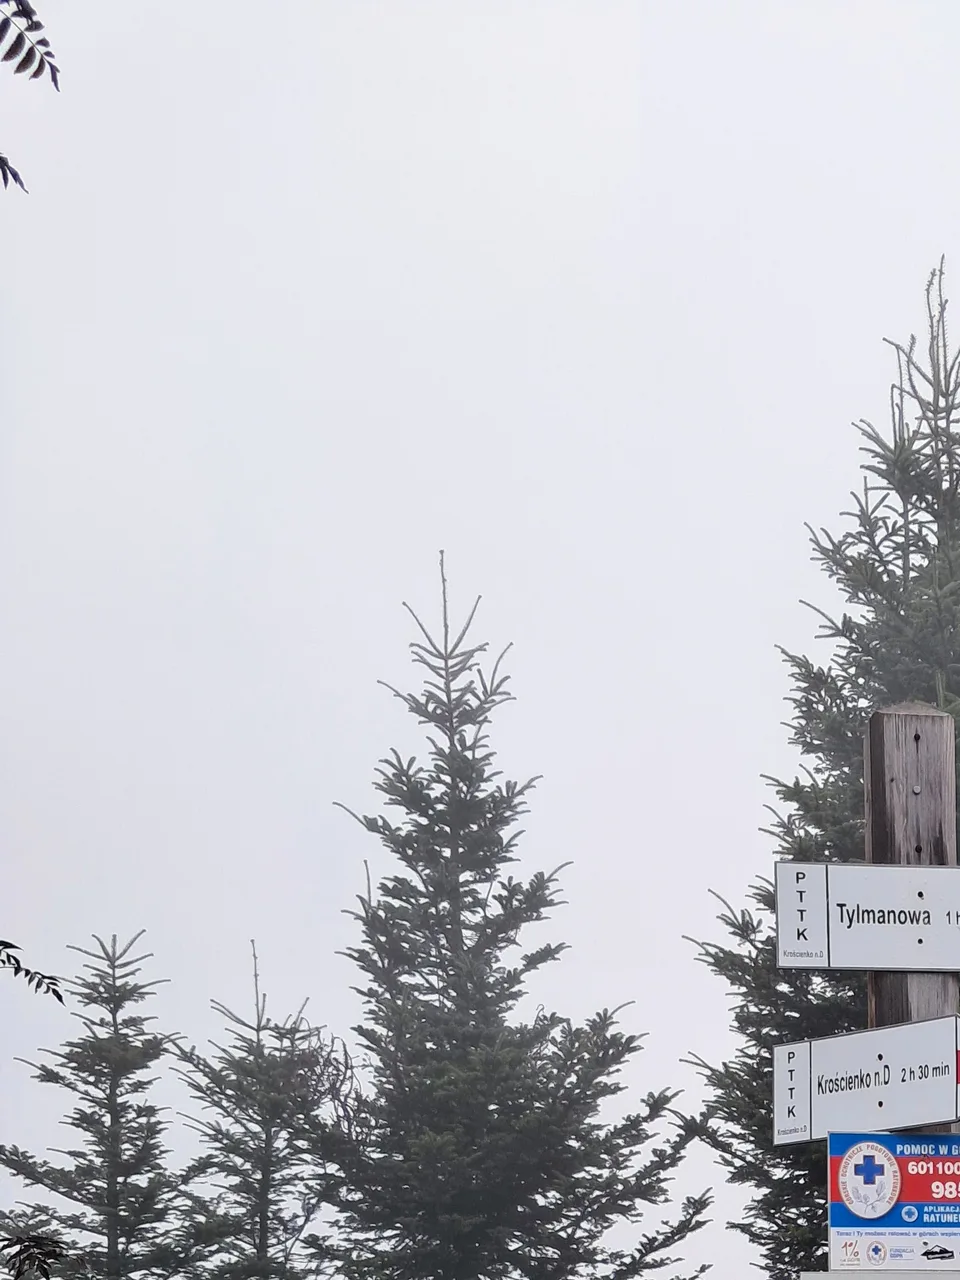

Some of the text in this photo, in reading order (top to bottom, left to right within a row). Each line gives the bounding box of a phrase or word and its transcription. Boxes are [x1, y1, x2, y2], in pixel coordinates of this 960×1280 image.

[836, 903, 931, 929] Tylmanowa
[945, 911, 952, 925] 1
[817, 1061, 950, 1095] Krościenko n.D 2 h 30 min
[896, 1144, 936, 1155] POMOC
[938, 1145, 949, 1155] W
